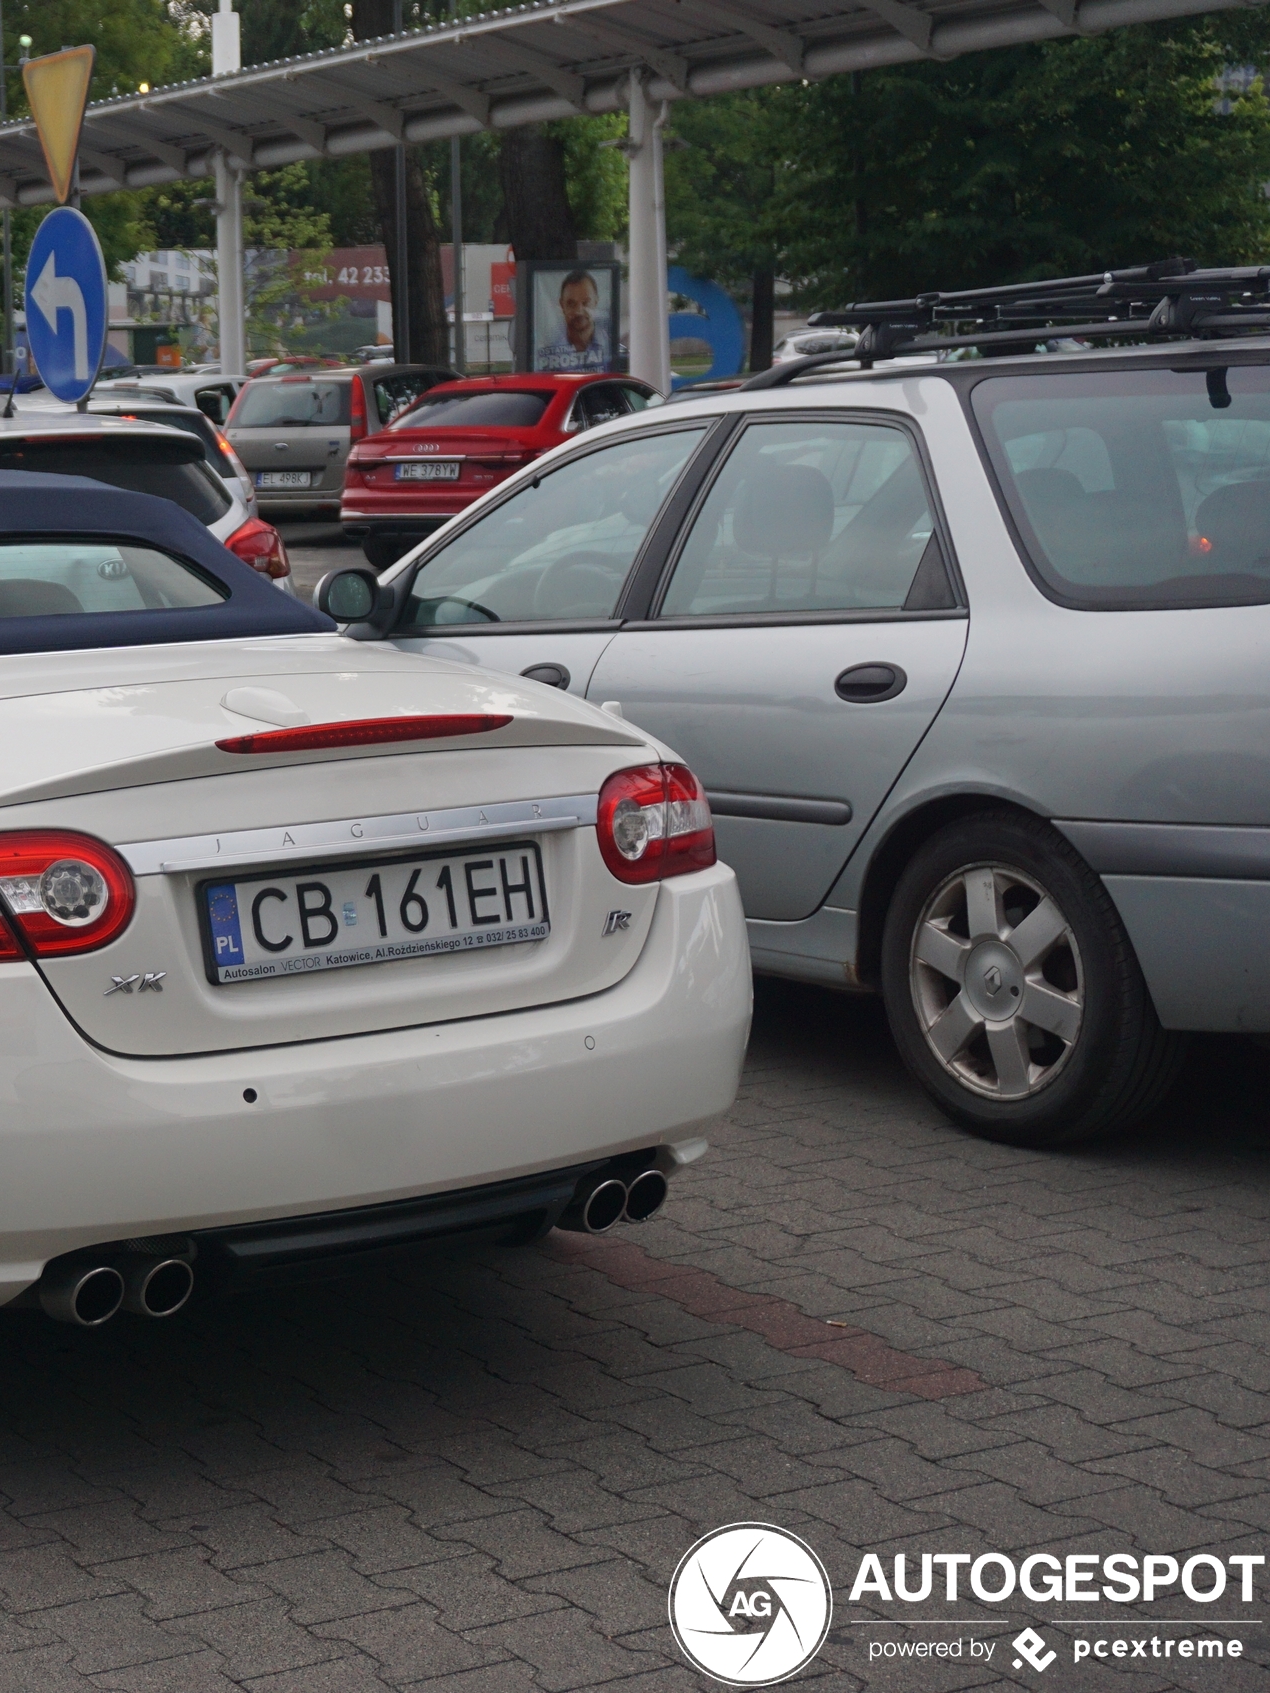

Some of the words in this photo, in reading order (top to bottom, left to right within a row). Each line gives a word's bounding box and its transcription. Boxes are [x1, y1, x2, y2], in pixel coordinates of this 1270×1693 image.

[338, 266, 359, 284] 42
[263, 473, 275, 484] EL
[403, 464, 418, 477] WE
[421, 463, 457, 477] 378YW
[215, 803, 543, 854] JAGUAR
[251, 881, 339, 953] CB
[364, 854, 536, 938] 161EH
[215, 935, 240, 955] PL
[223, 964, 276, 980] Autosalon
[280, 956, 321, 972] VECTOR
[326, 951, 373, 966] Katowice,
[462, 936, 474, 946] 12
[486, 932, 504, 943] 032/
[506, 930, 517, 940] 25
[518, 928, 529, 939] 83
[530, 926, 546, 937] 400
[103, 970, 168, 996] XK
